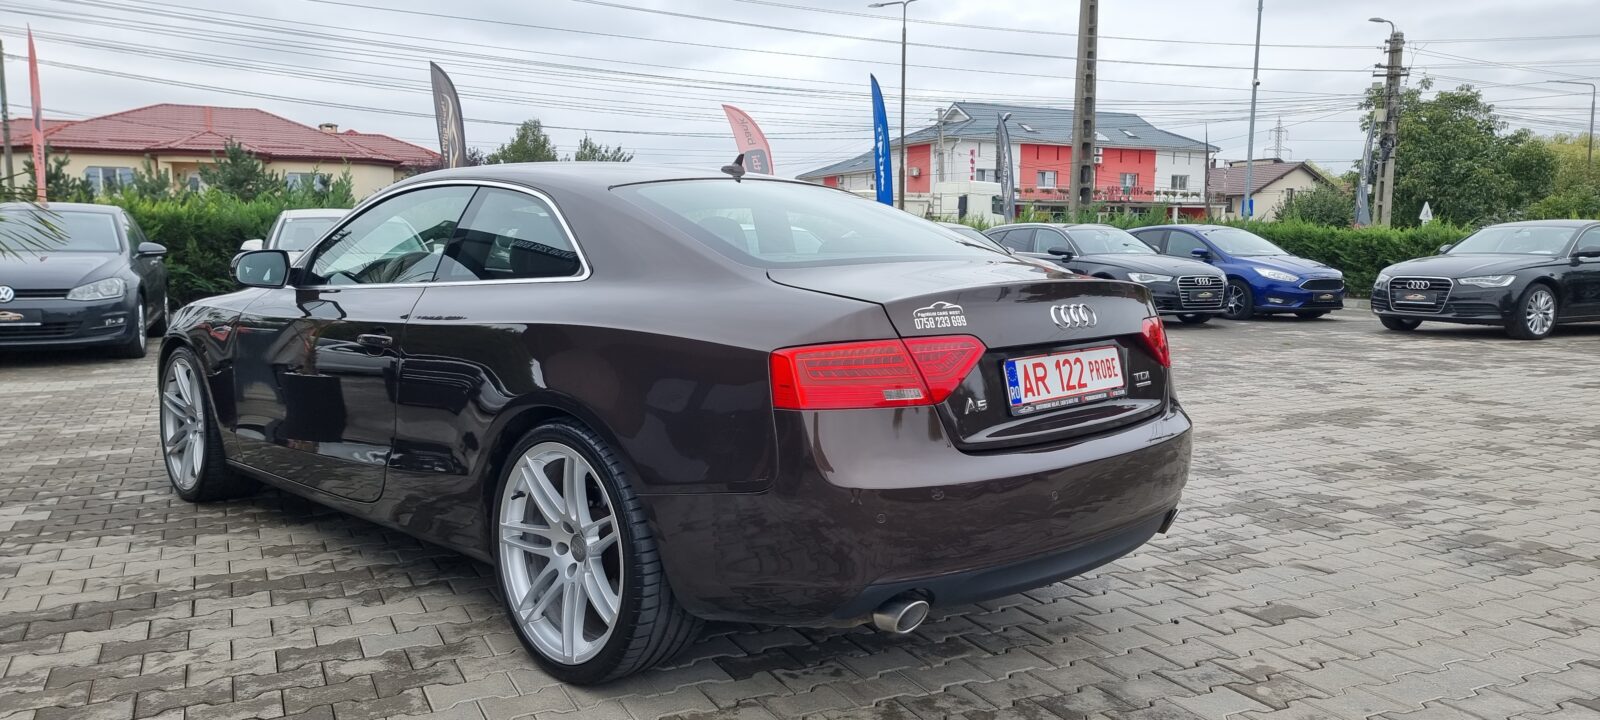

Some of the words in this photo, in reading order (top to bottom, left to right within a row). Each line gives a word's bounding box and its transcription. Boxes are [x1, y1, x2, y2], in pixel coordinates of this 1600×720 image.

[914, 317, 936, 330] 0758
[935, 316, 951, 328] 233
[950, 315, 967, 327] 699
[1023, 361, 1051, 399] AR
[1055, 357, 1088, 392] 122
[1088, 357, 1119, 381] PROBE
[1133, 370, 1150, 381] TDI
[1010, 385, 1021, 400] RO
[964, 397, 988, 415] A5
